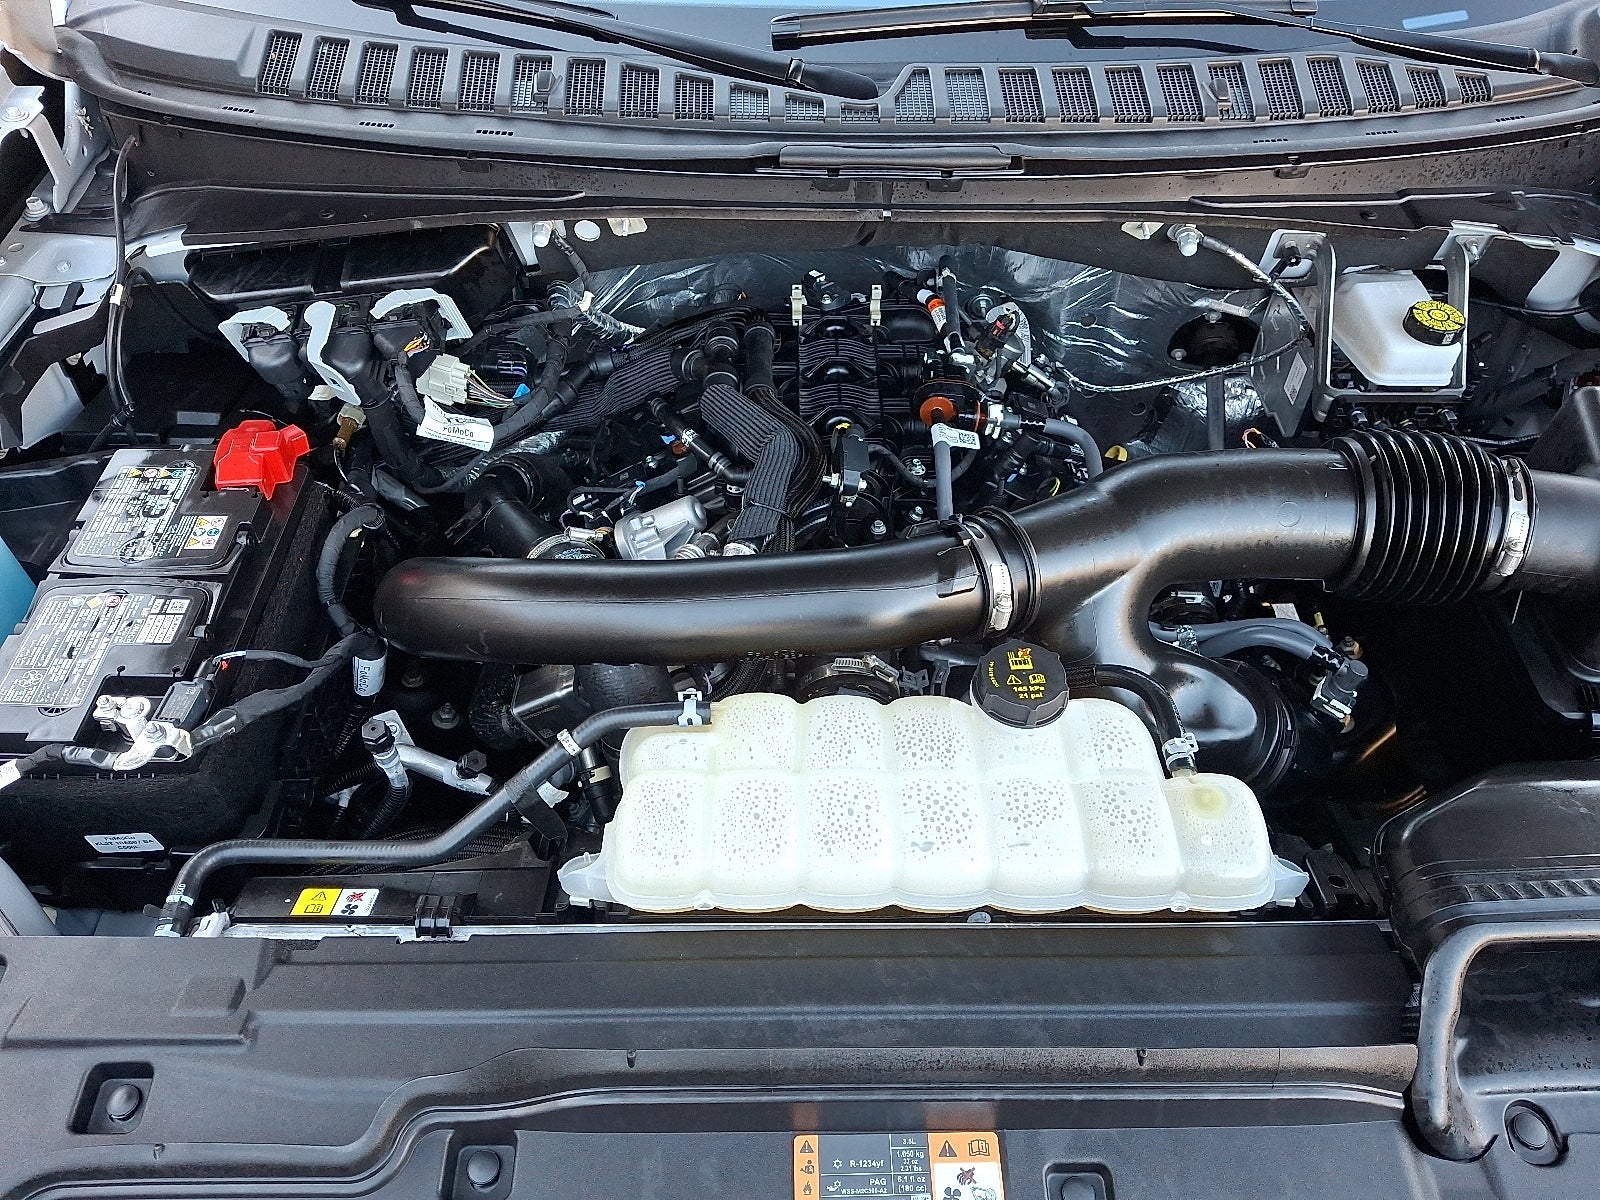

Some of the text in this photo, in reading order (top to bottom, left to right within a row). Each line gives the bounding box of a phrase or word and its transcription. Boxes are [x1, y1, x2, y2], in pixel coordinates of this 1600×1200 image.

[915, 1149, 925, 1159] kg
[849, 1159, 884, 1169] R-1234yf
[869, 1178, 887, 1186] PAG
[915, 1184, 927, 1193] cc)
